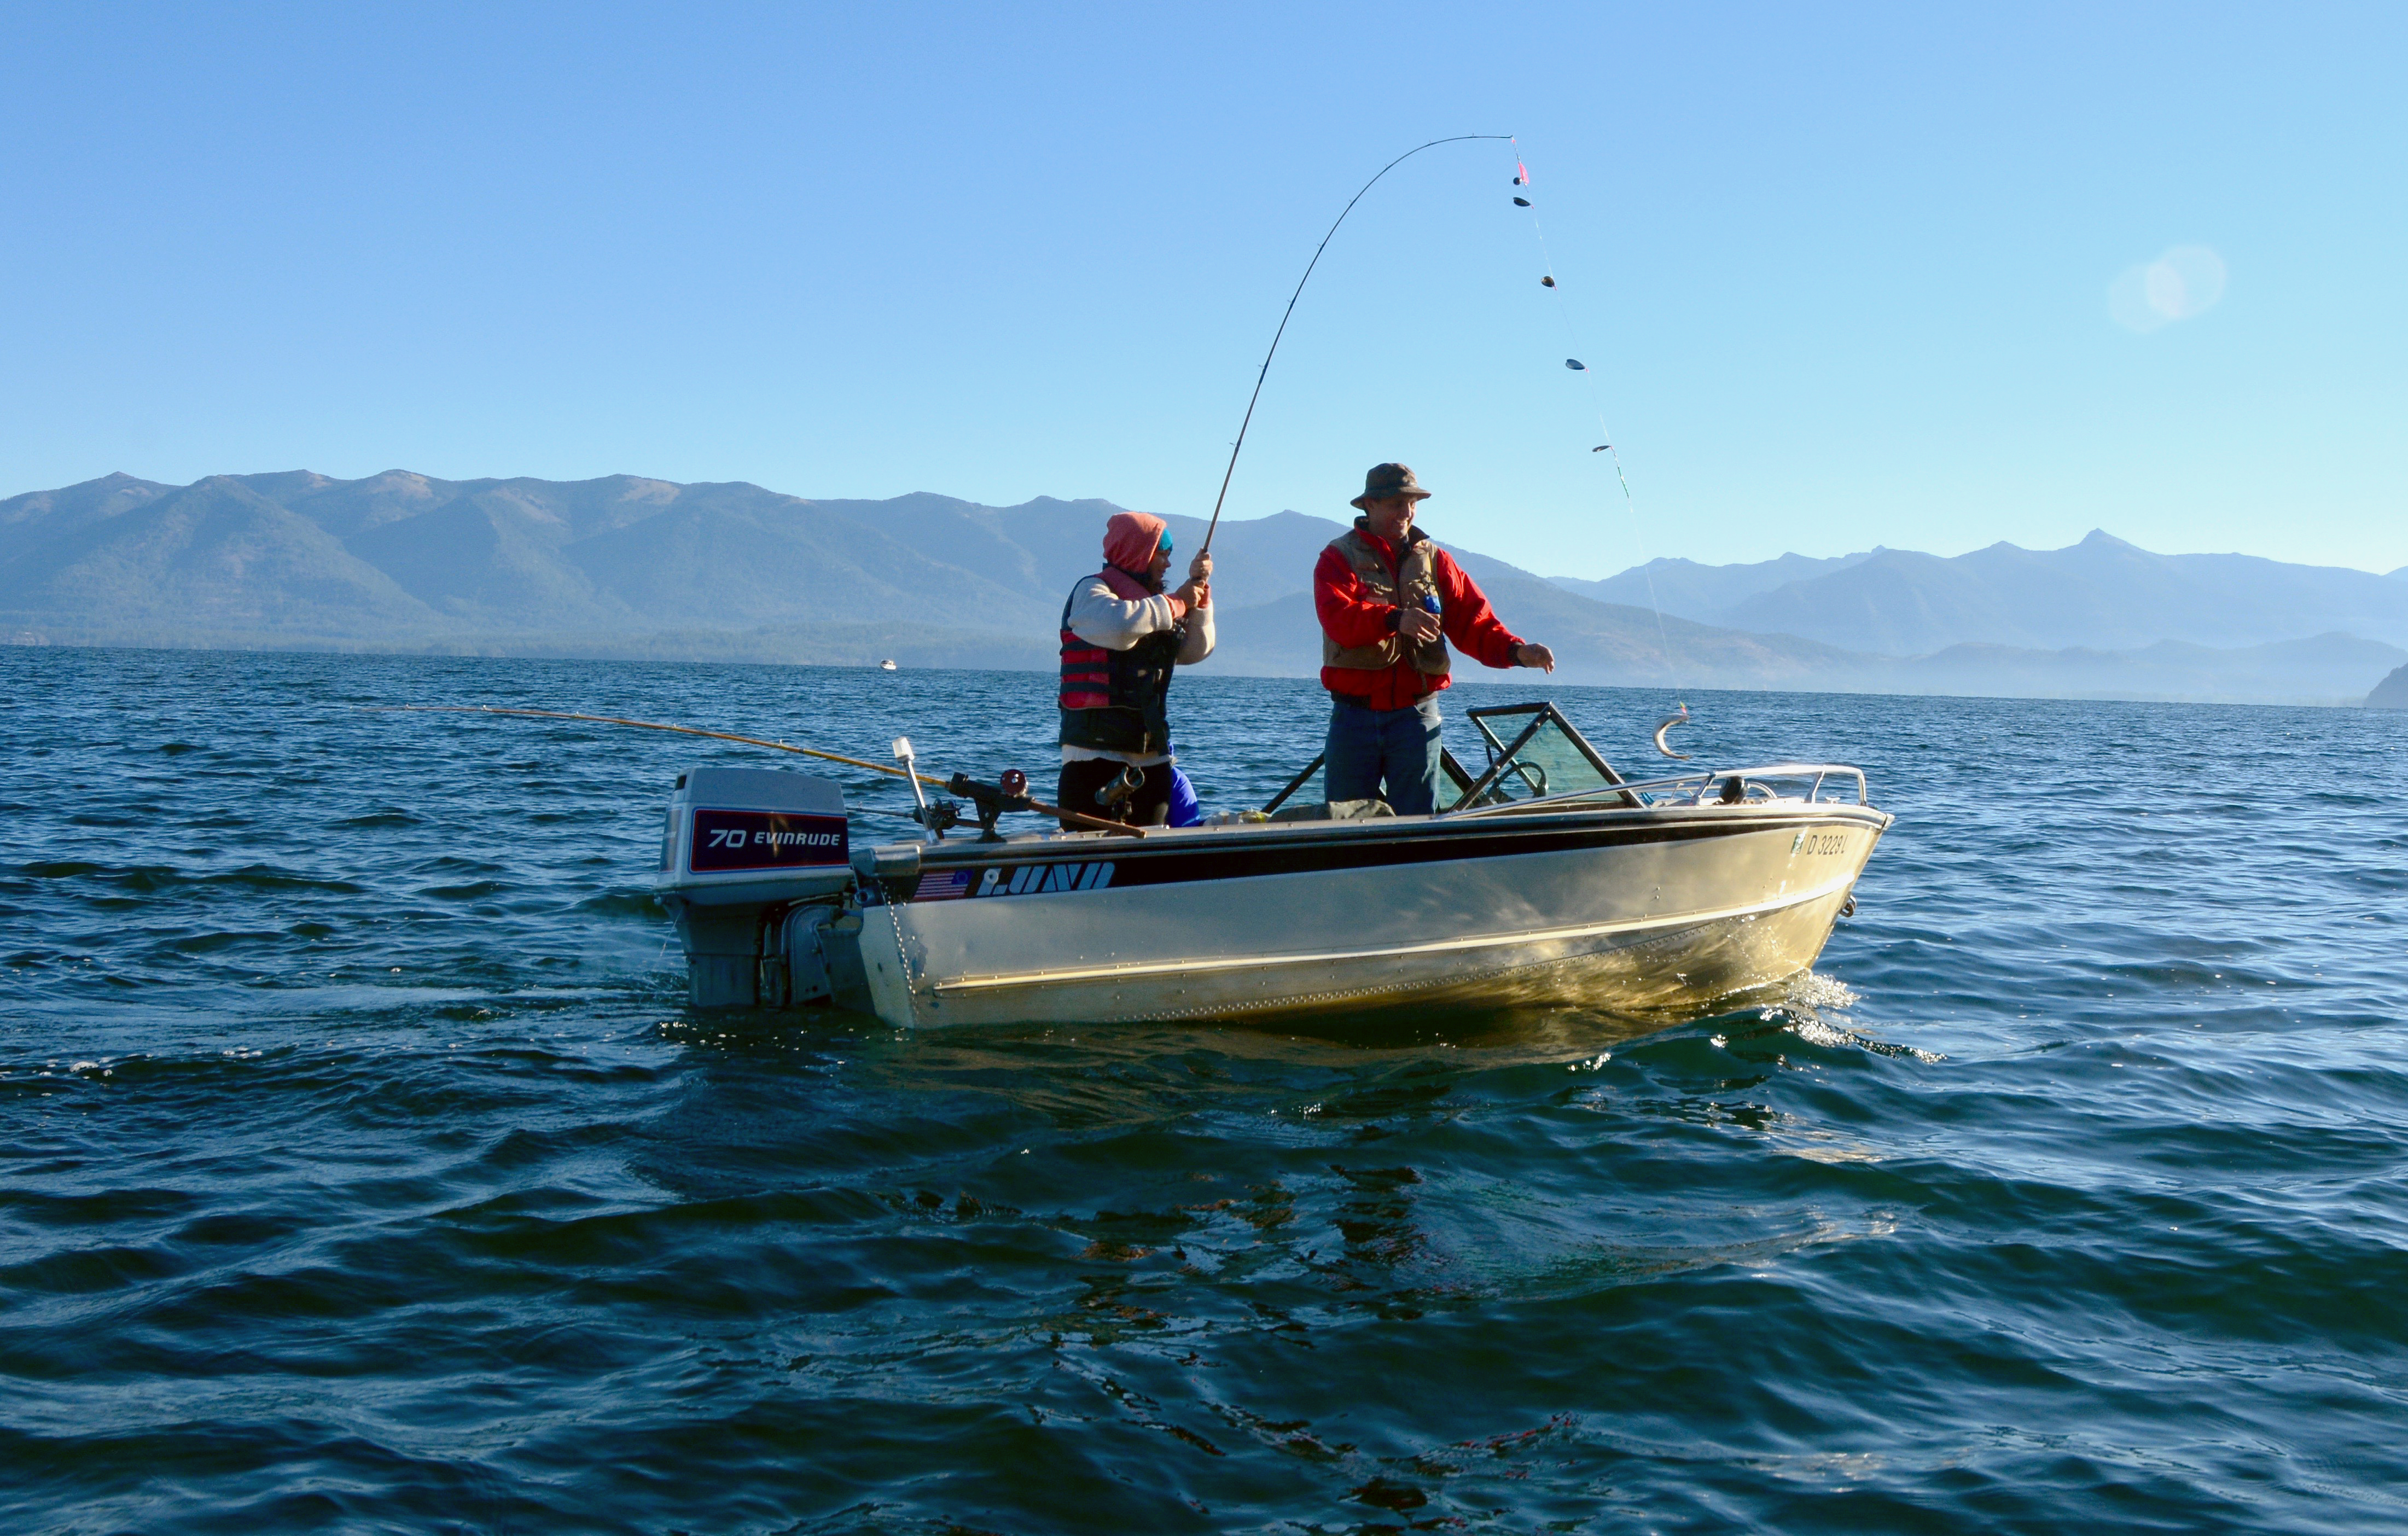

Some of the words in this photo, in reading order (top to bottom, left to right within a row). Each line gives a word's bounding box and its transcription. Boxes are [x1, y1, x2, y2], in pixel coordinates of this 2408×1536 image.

[708, 829, 747, 848] 70
[754, 831, 841, 846] EVINRUDE
[976, 862, 1115, 896] LUND
